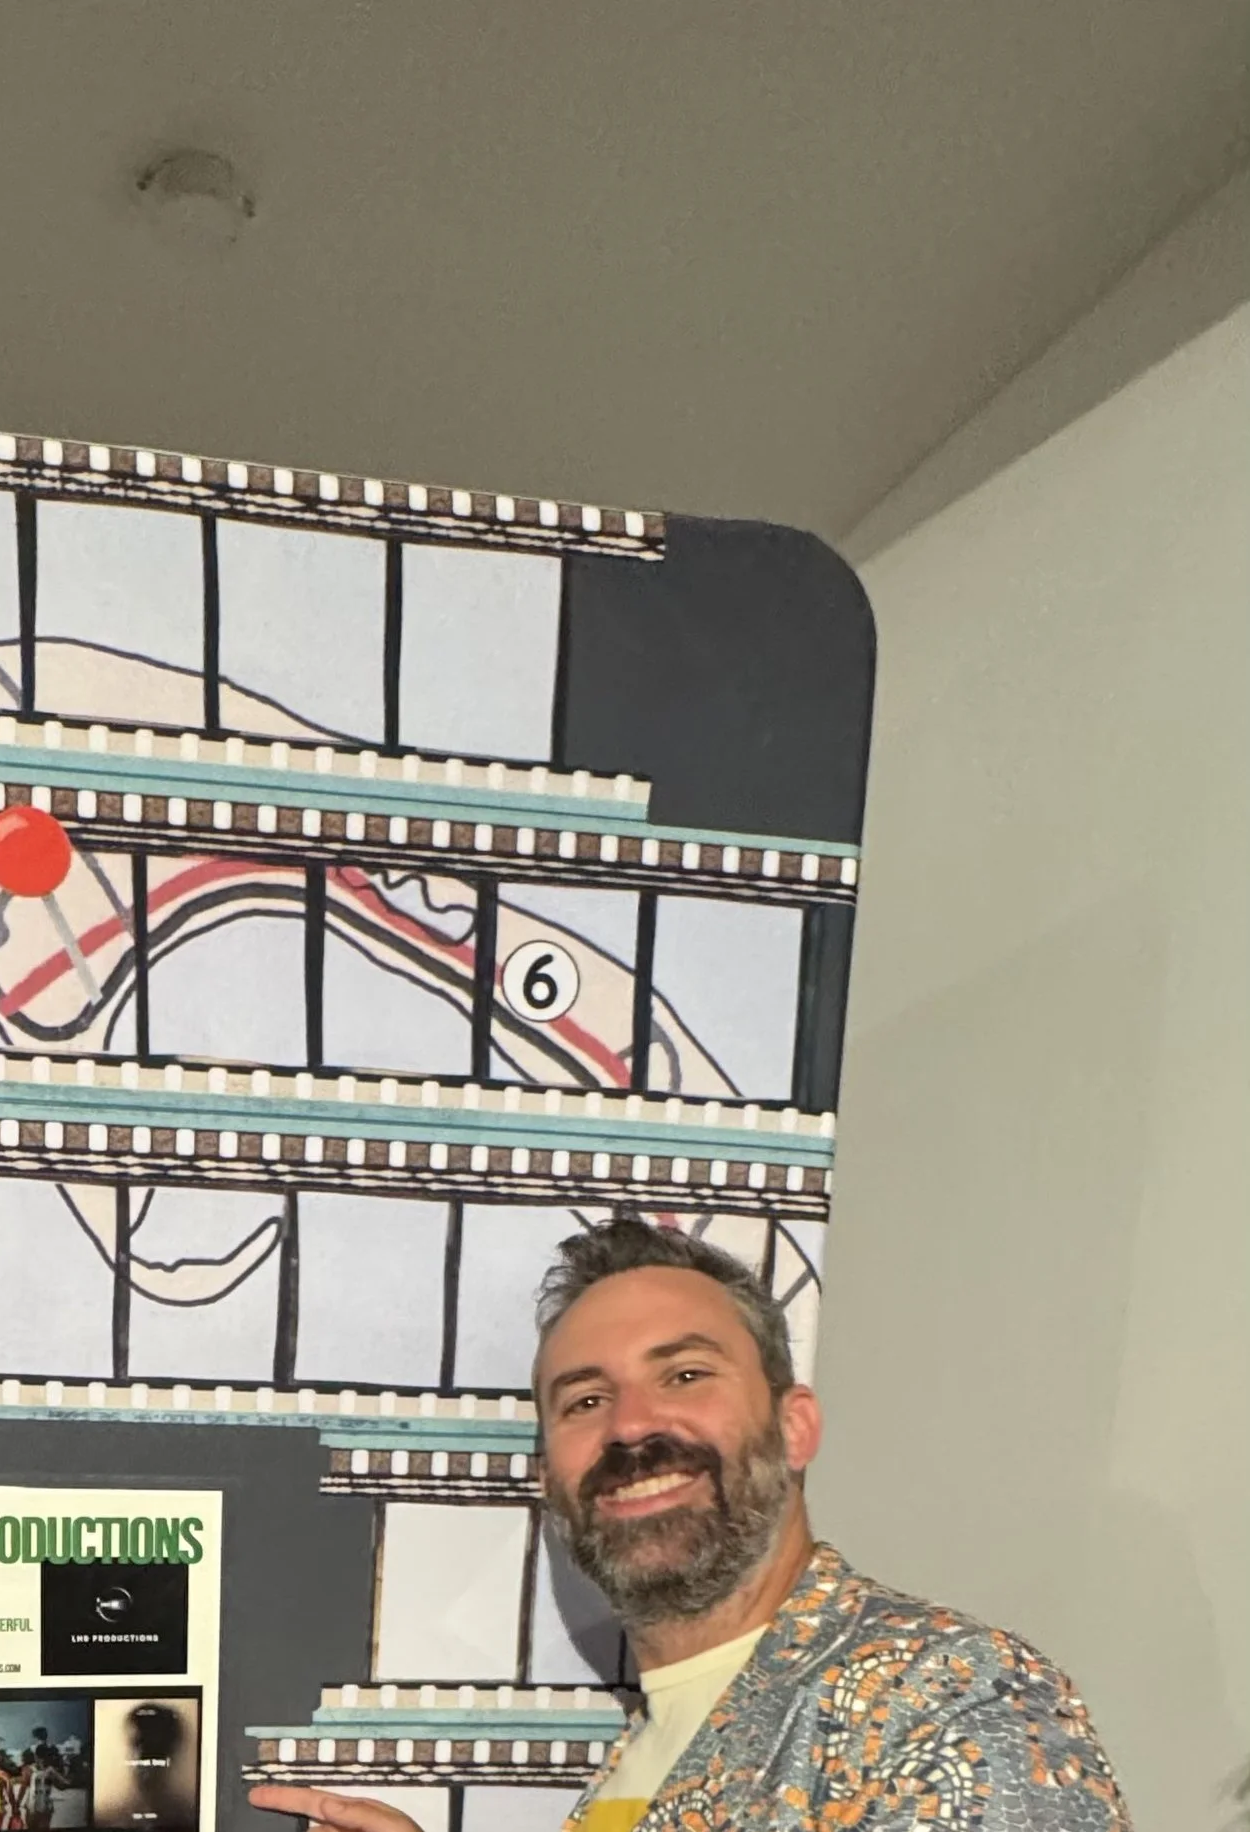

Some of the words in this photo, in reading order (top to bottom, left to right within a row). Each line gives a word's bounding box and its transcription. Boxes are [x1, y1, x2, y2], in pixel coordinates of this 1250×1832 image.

[523, 954, 558, 1009] 6
[71, 1634, 89, 1643] LHB
[92, 1634, 159, 1643] PRODUCTIONS
